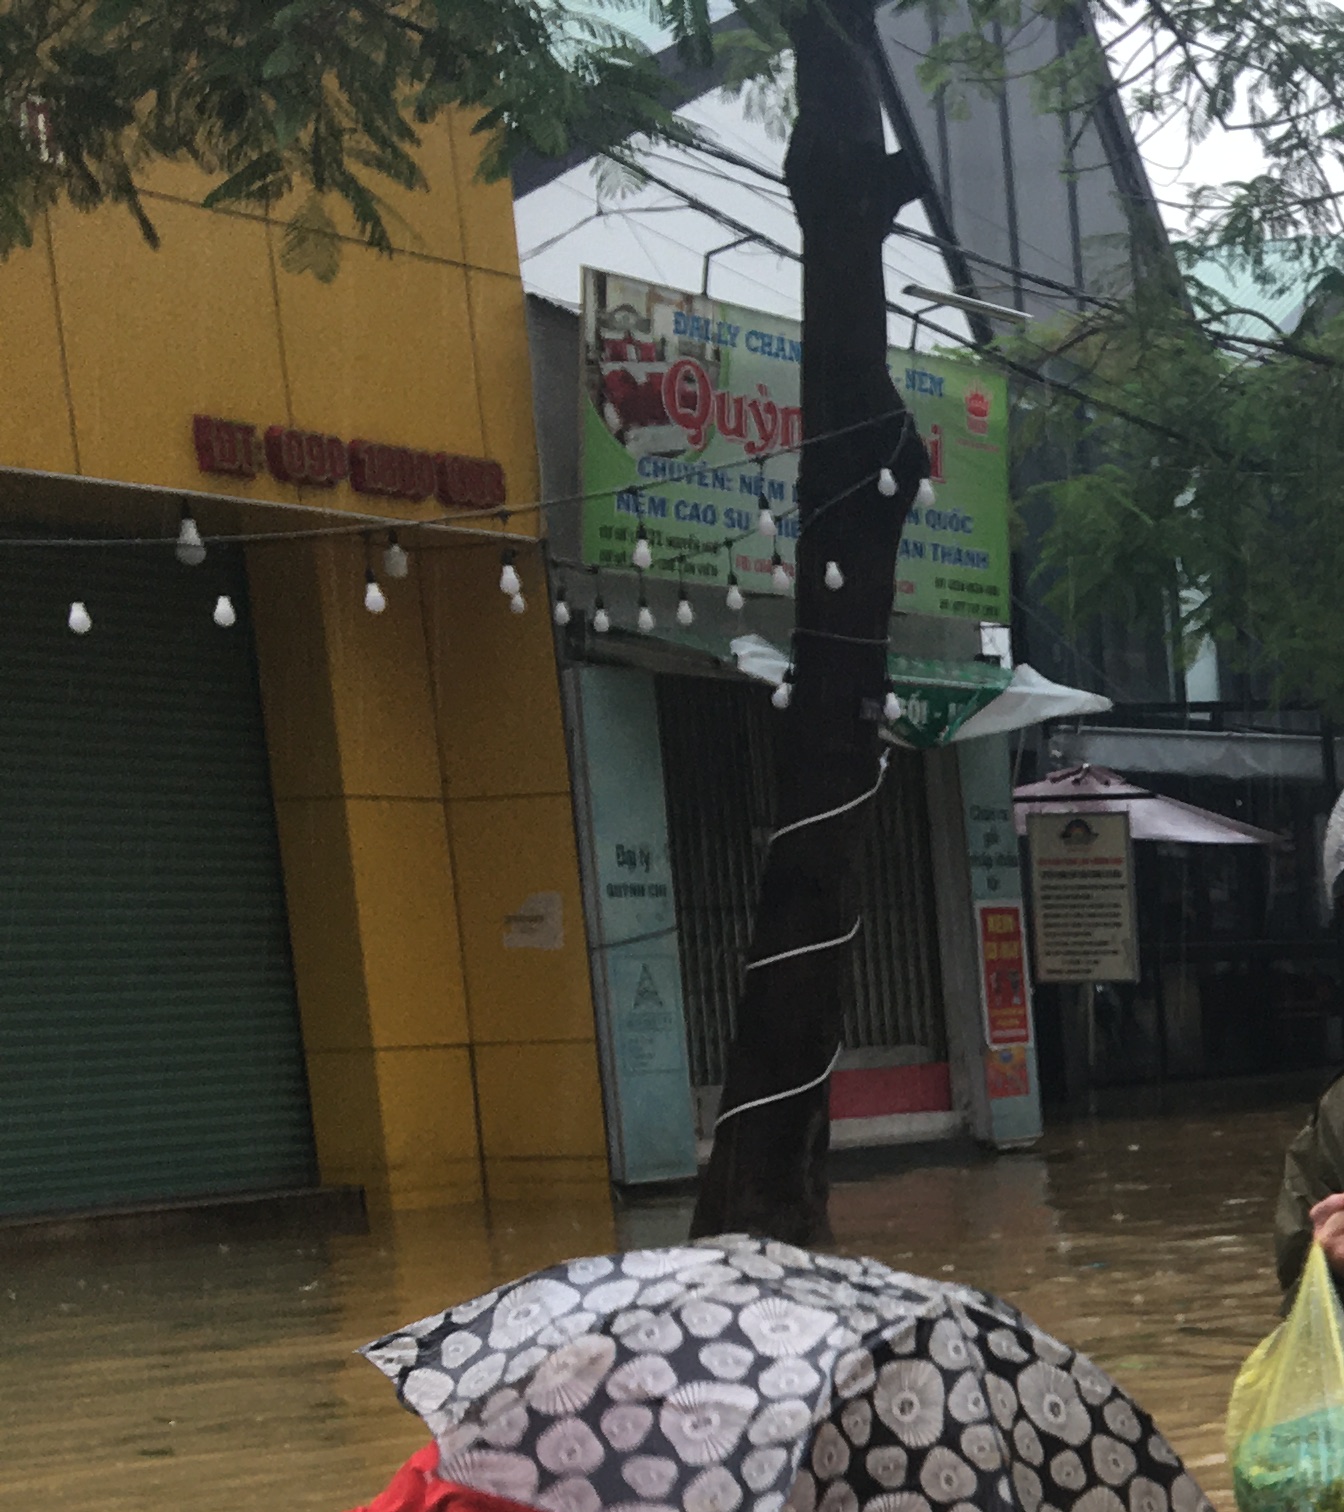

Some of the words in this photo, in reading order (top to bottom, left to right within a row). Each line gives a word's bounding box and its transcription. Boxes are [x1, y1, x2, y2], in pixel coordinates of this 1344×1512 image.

[661, 358, 802, 456] Quỳn
[674, 499, 717, 526] CAO
[723, 507, 751, 531] SU
